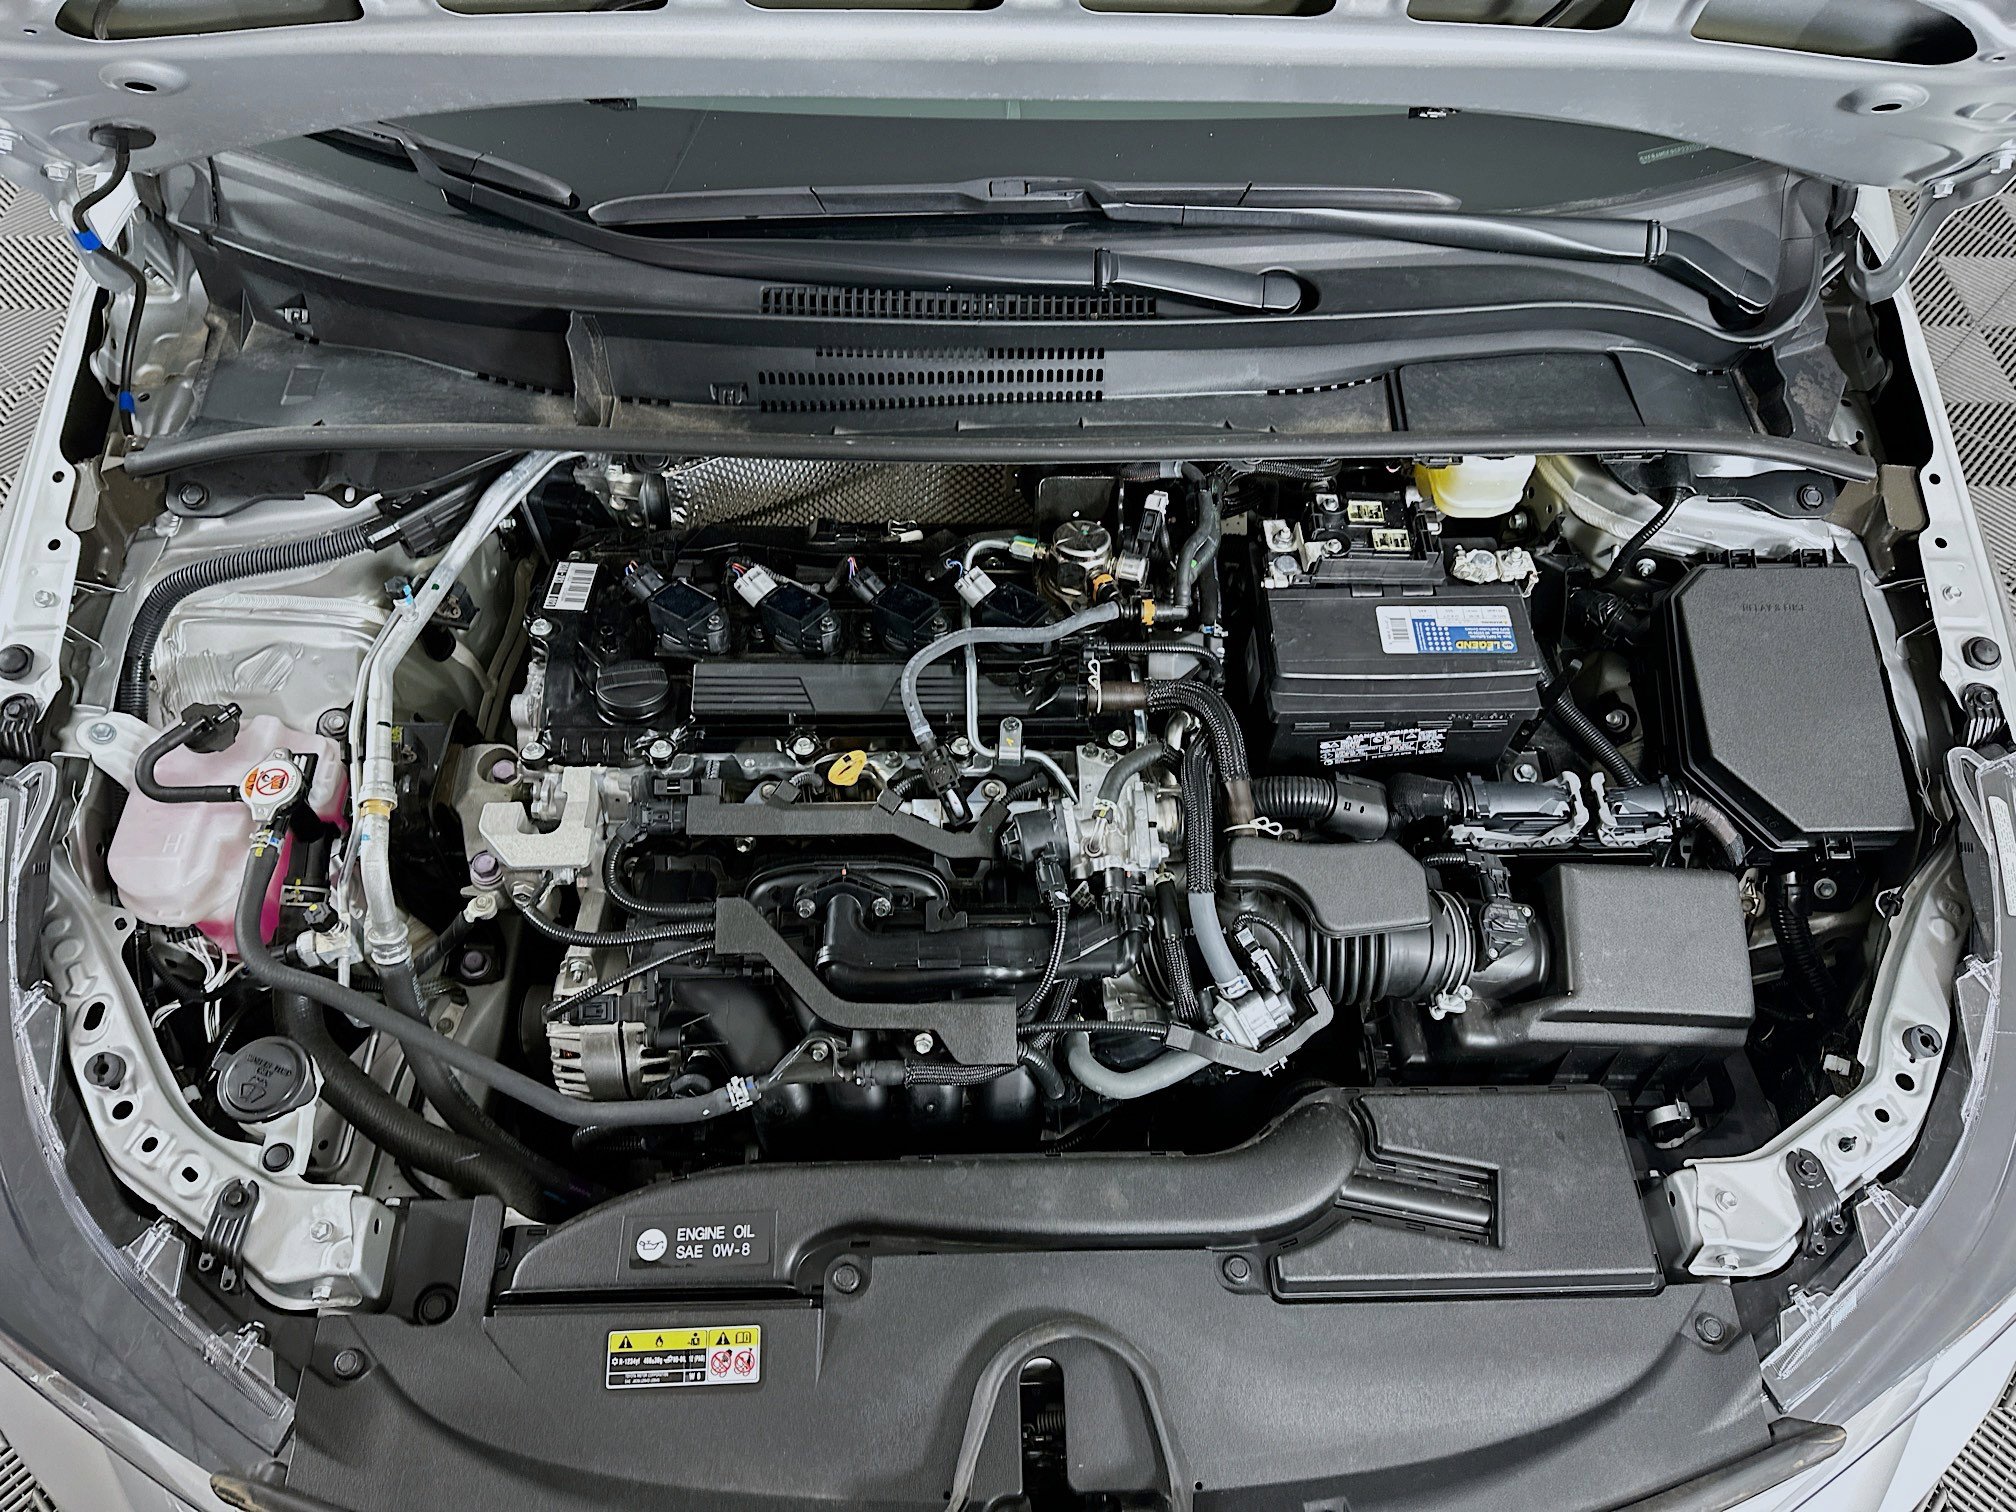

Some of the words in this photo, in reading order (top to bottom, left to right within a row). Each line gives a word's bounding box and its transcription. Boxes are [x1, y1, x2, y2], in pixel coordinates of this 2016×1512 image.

[1455, 640, 1501, 651] LEGEND
[677, 1226, 725, 1241] ENGINE
[733, 1224, 756, 1239] OIL
[675, 1244, 704, 1260] SAE
[712, 1242, 751, 1258] 0W-8
